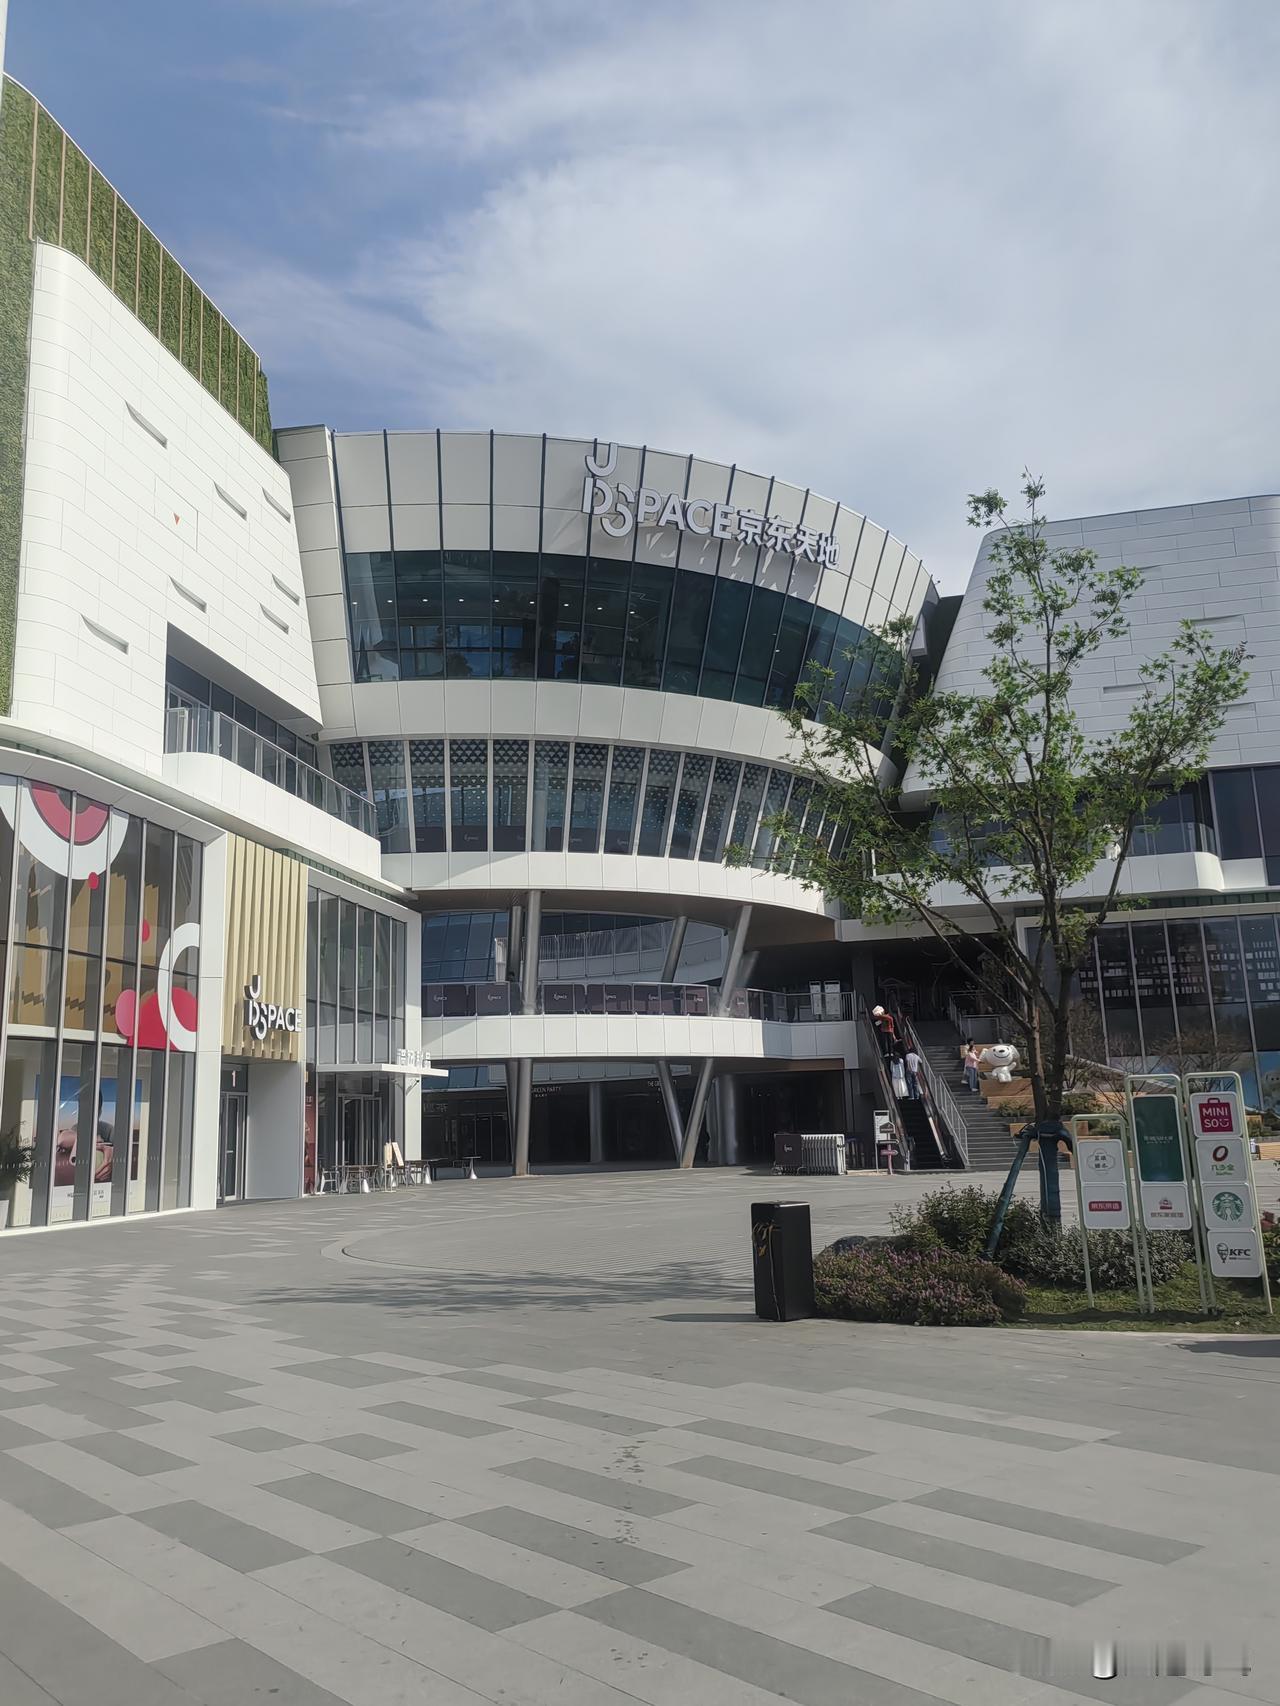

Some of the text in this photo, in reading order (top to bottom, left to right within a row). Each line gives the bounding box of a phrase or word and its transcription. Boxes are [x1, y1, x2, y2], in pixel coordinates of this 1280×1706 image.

[735, 508, 841, 570] 京东天地
[231, 1070, 237, 1088] 1
[1202, 1107, 1228, 1117] MINI
